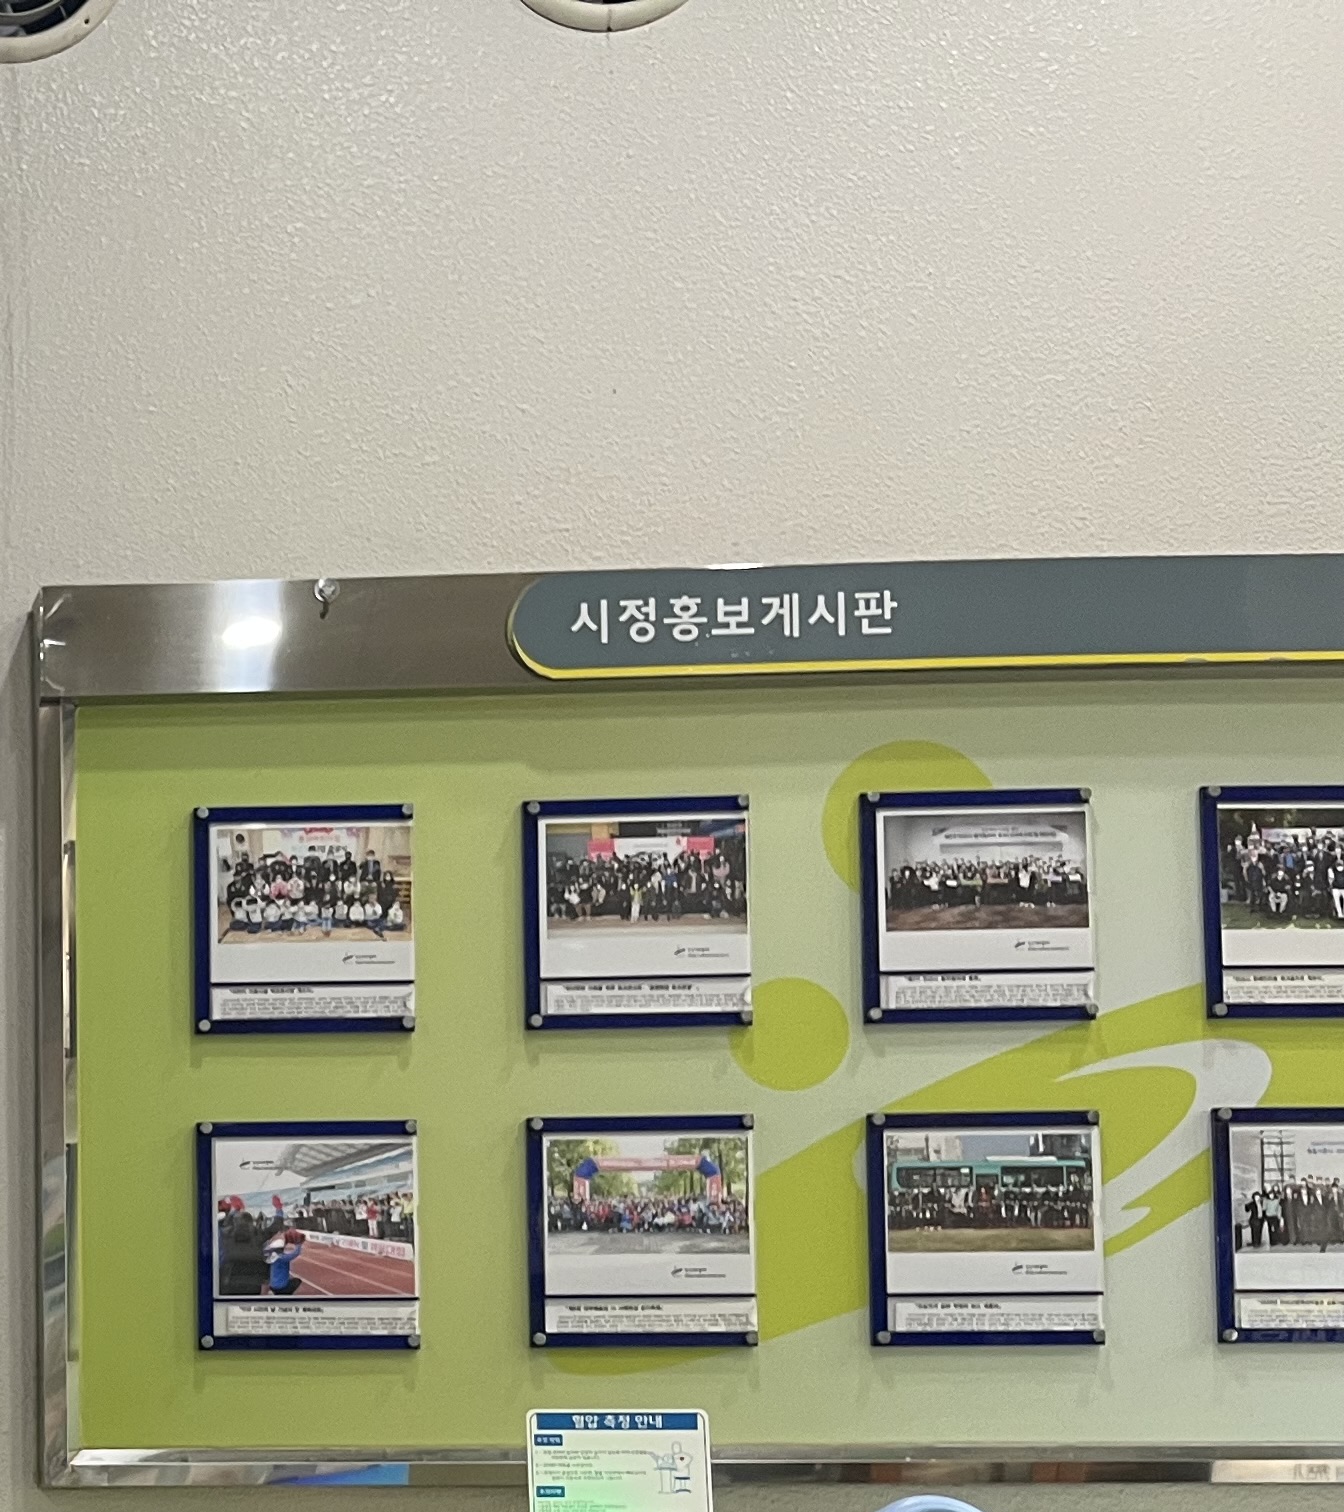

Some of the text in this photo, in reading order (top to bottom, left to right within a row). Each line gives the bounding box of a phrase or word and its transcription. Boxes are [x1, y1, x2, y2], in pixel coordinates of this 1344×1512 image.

[571, 590, 897, 645] 시정홍보게시판
[572, 1415, 600, 1429] 혈압
[634, 1415, 663, 1429] 안내
